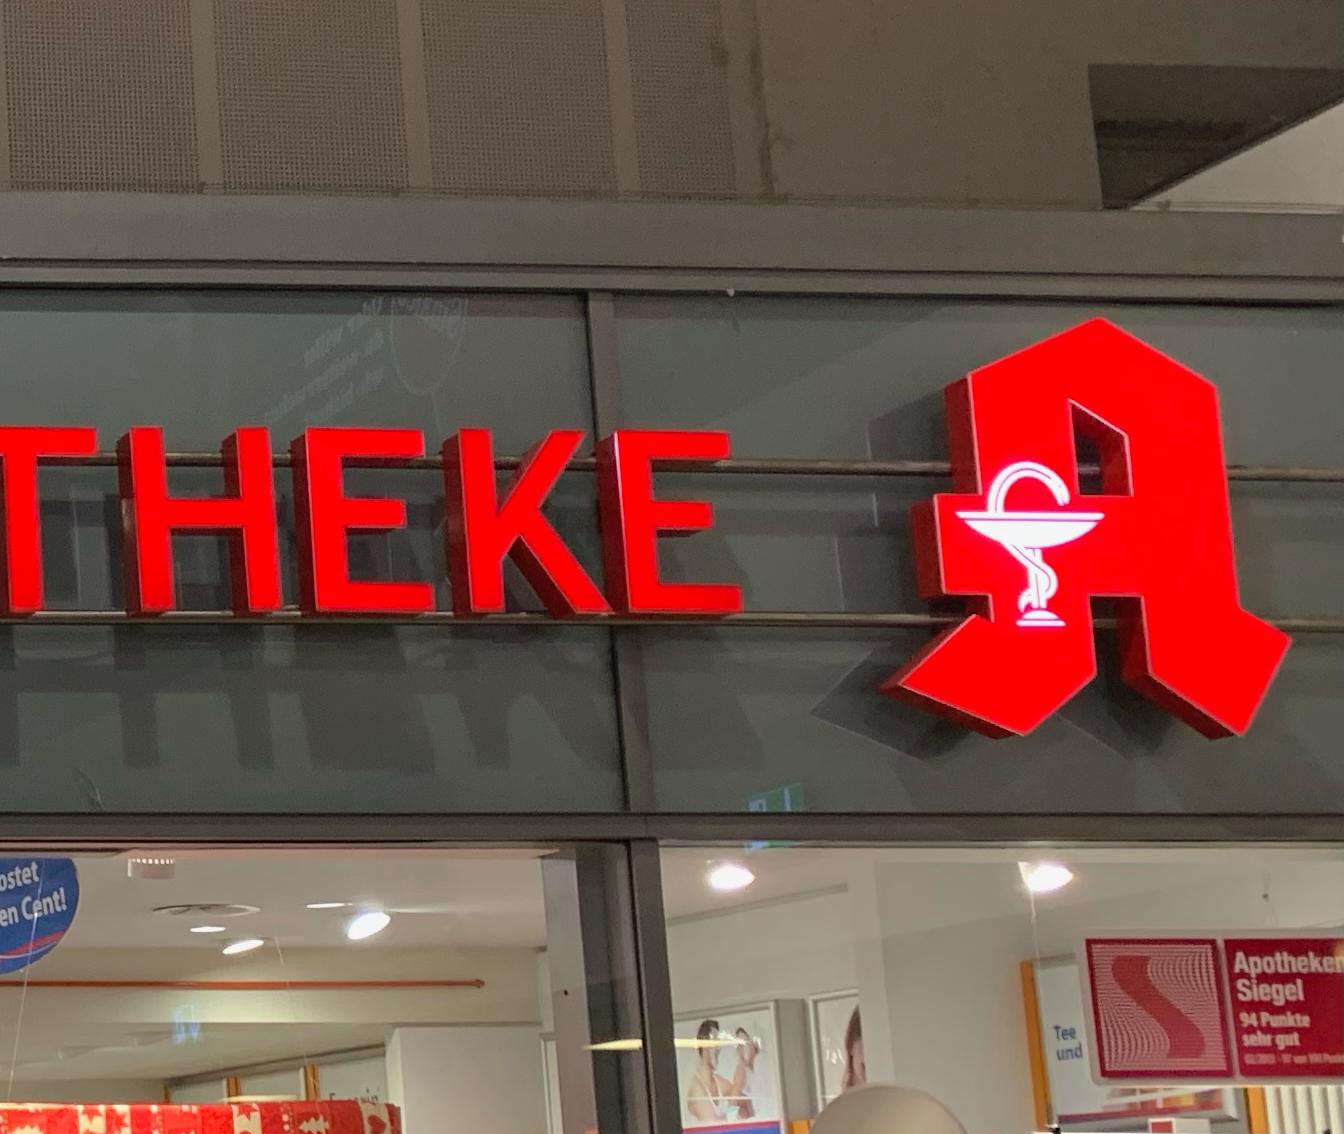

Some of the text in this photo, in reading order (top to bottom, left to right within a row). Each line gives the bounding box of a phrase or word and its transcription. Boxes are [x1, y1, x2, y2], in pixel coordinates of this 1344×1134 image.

[21, 887, 68, 921] Cent!
[1234, 950, 1344, 978] Apotheken
[1236, 979, 1305, 1006] Siegel
[1240, 1011, 1311, 1028] 94 Punkte
[1053, 1025, 1077, 1040] Tee
[1242, 1031, 1301, 1050] sehr gut
[1056, 1041, 1083, 1061] und
